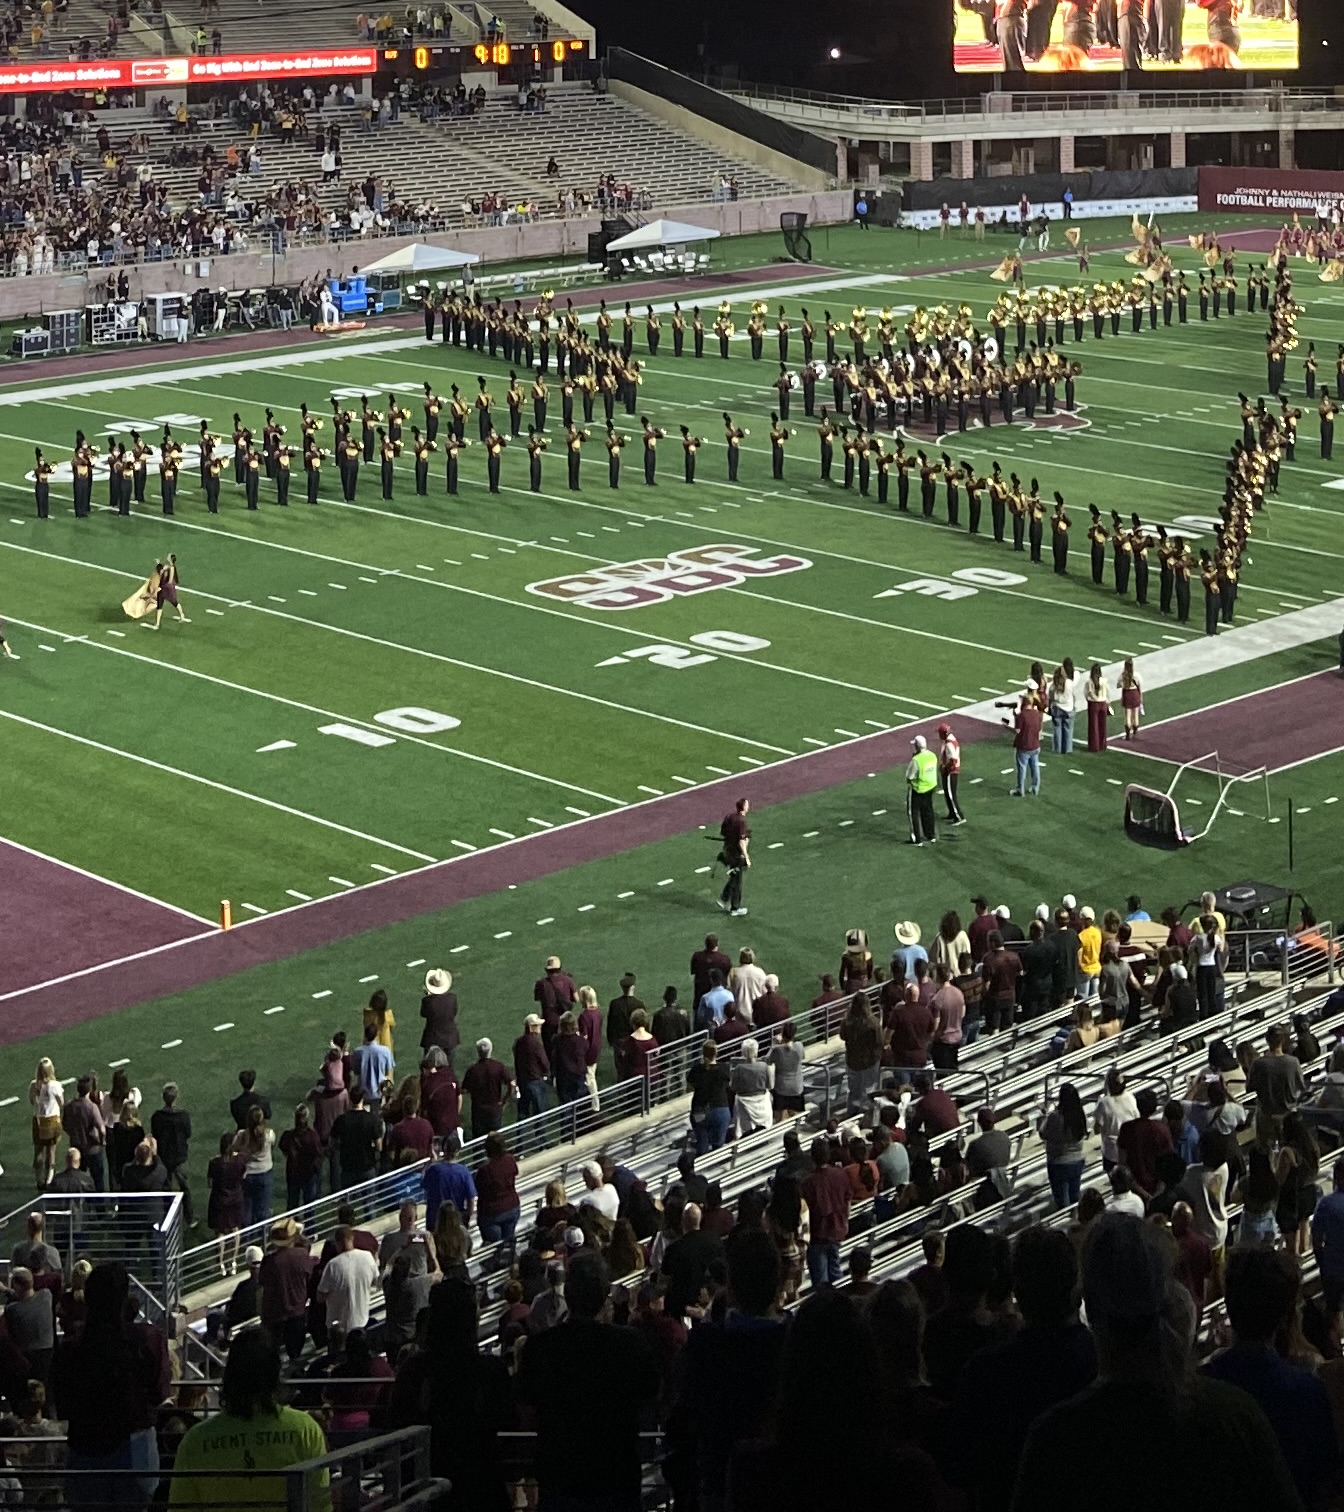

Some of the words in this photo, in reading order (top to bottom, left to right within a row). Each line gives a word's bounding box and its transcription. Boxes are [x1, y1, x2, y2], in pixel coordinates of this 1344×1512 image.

[1216, 194, 1264, 207] FOOTBALL
[896, 568, 1028, 600] 30
[622, 630, 771, 669] 20
[316, 706, 462, 748] 10
